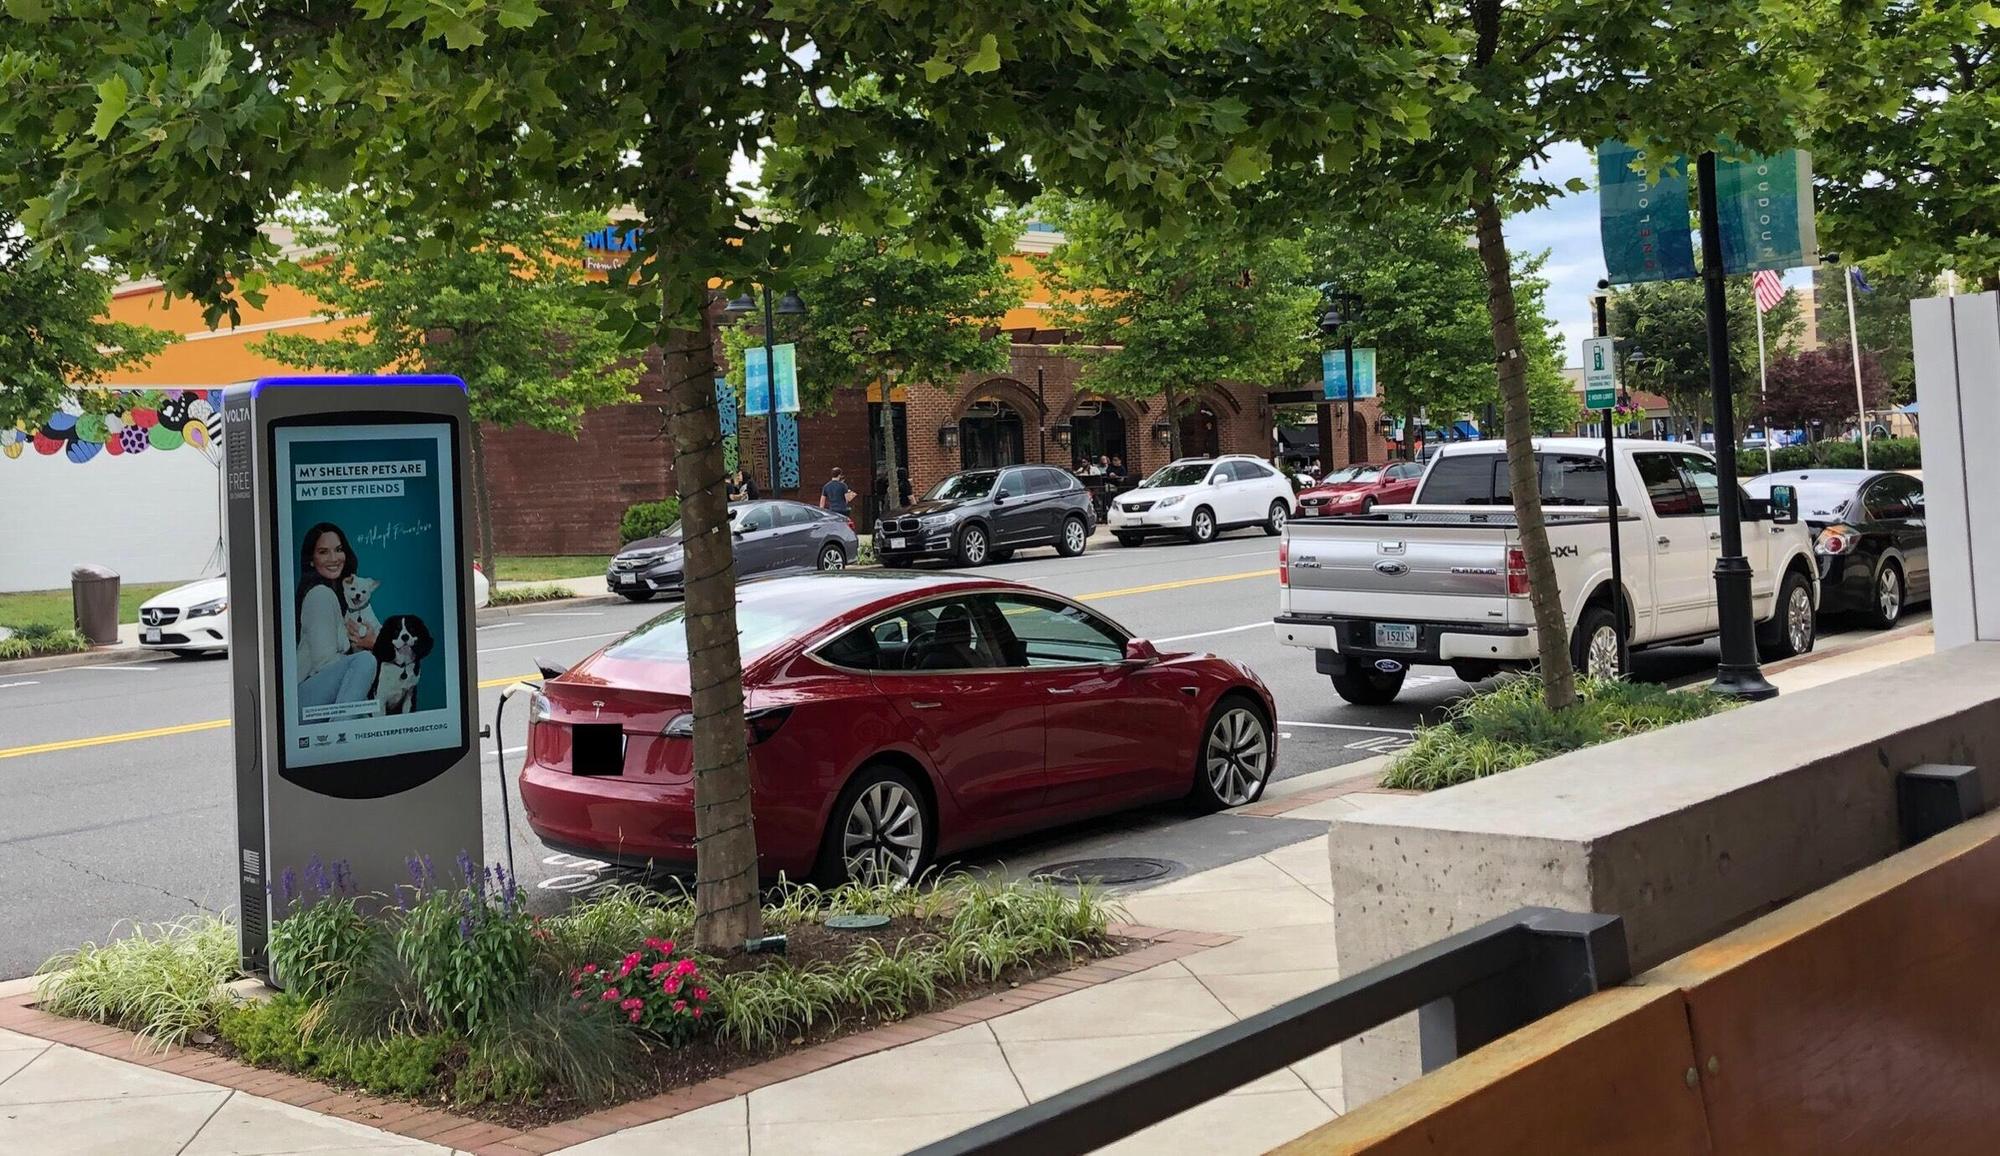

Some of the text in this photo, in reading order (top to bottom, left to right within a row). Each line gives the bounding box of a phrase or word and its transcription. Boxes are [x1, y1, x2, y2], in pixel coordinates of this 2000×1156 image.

[1756, 164, 1775, 258] OUDOUN
[225, 407, 250, 423] VOLTA
[299, 463, 422, 478] MY SHELTER PETS ARE
[228, 471, 251, 491] FREE
[301, 483, 400, 497] MY BEST FRIENDS
[354, 722, 448, 740] THESHELTERPETPROJECT.ORG
